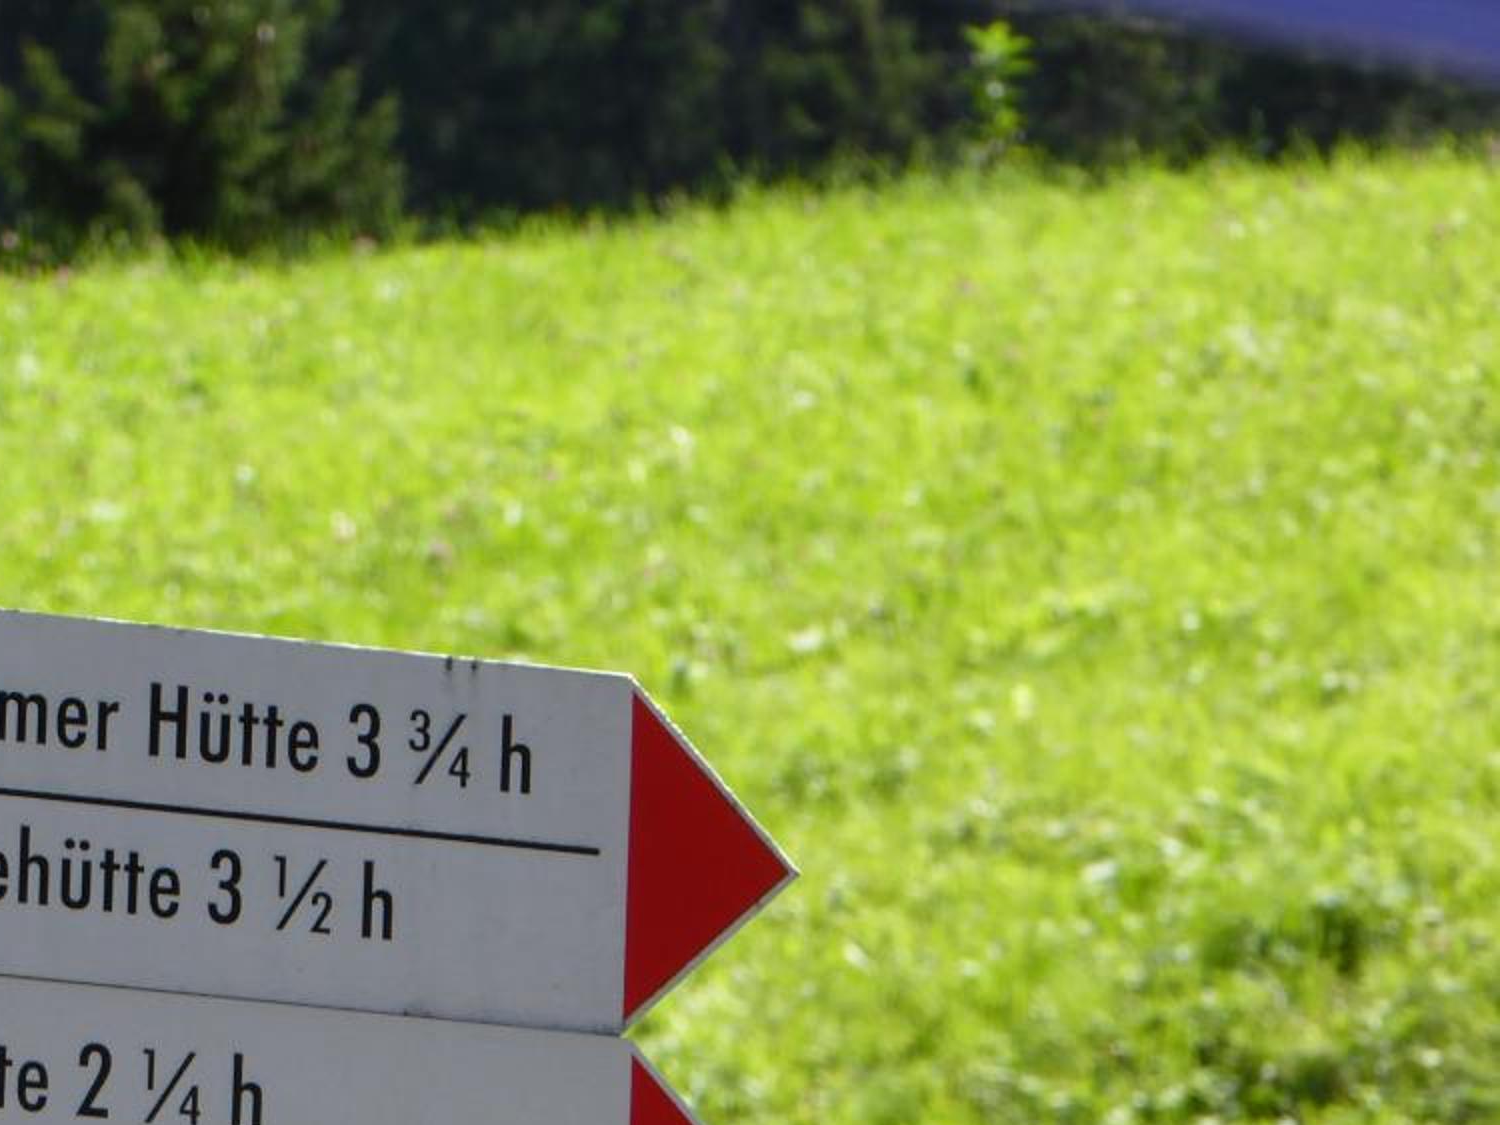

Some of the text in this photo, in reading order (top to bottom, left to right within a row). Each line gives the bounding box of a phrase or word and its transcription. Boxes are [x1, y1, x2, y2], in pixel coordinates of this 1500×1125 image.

[147, 681, 320, 774] Hütte
[345, 702, 382, 780] 3
[498, 713, 533, 796] h
[206, 847, 243, 926] 3
[360, 858, 394, 942] h
[74, 1041, 113, 1120] 2
